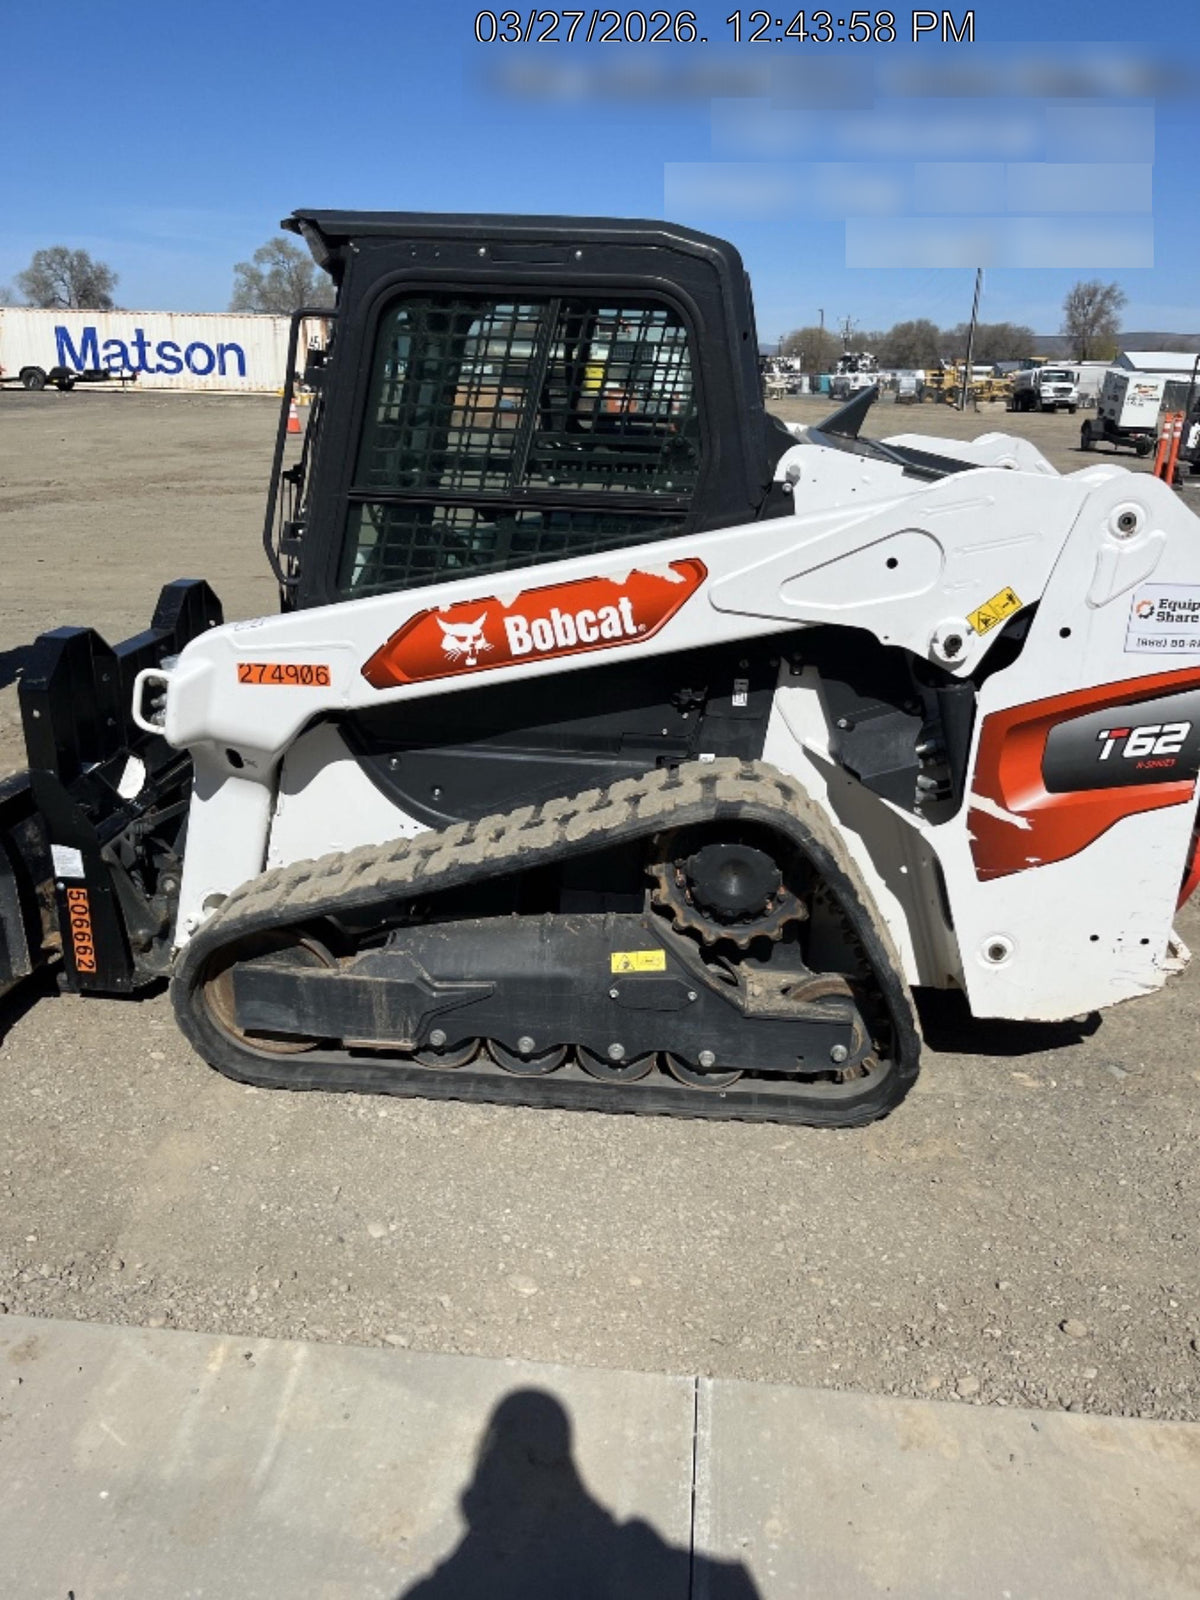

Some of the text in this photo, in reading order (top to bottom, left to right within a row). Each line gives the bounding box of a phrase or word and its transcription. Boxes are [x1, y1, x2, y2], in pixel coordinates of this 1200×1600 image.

[54, 325, 246, 377] Matson
[503, 597, 637, 655] Bobcat
[1156, 611, 1199, 623] Share
[238, 663, 330, 686] 274906
[1097, 720, 1192, 761] T62
[68, 889, 95, 970] 506662
